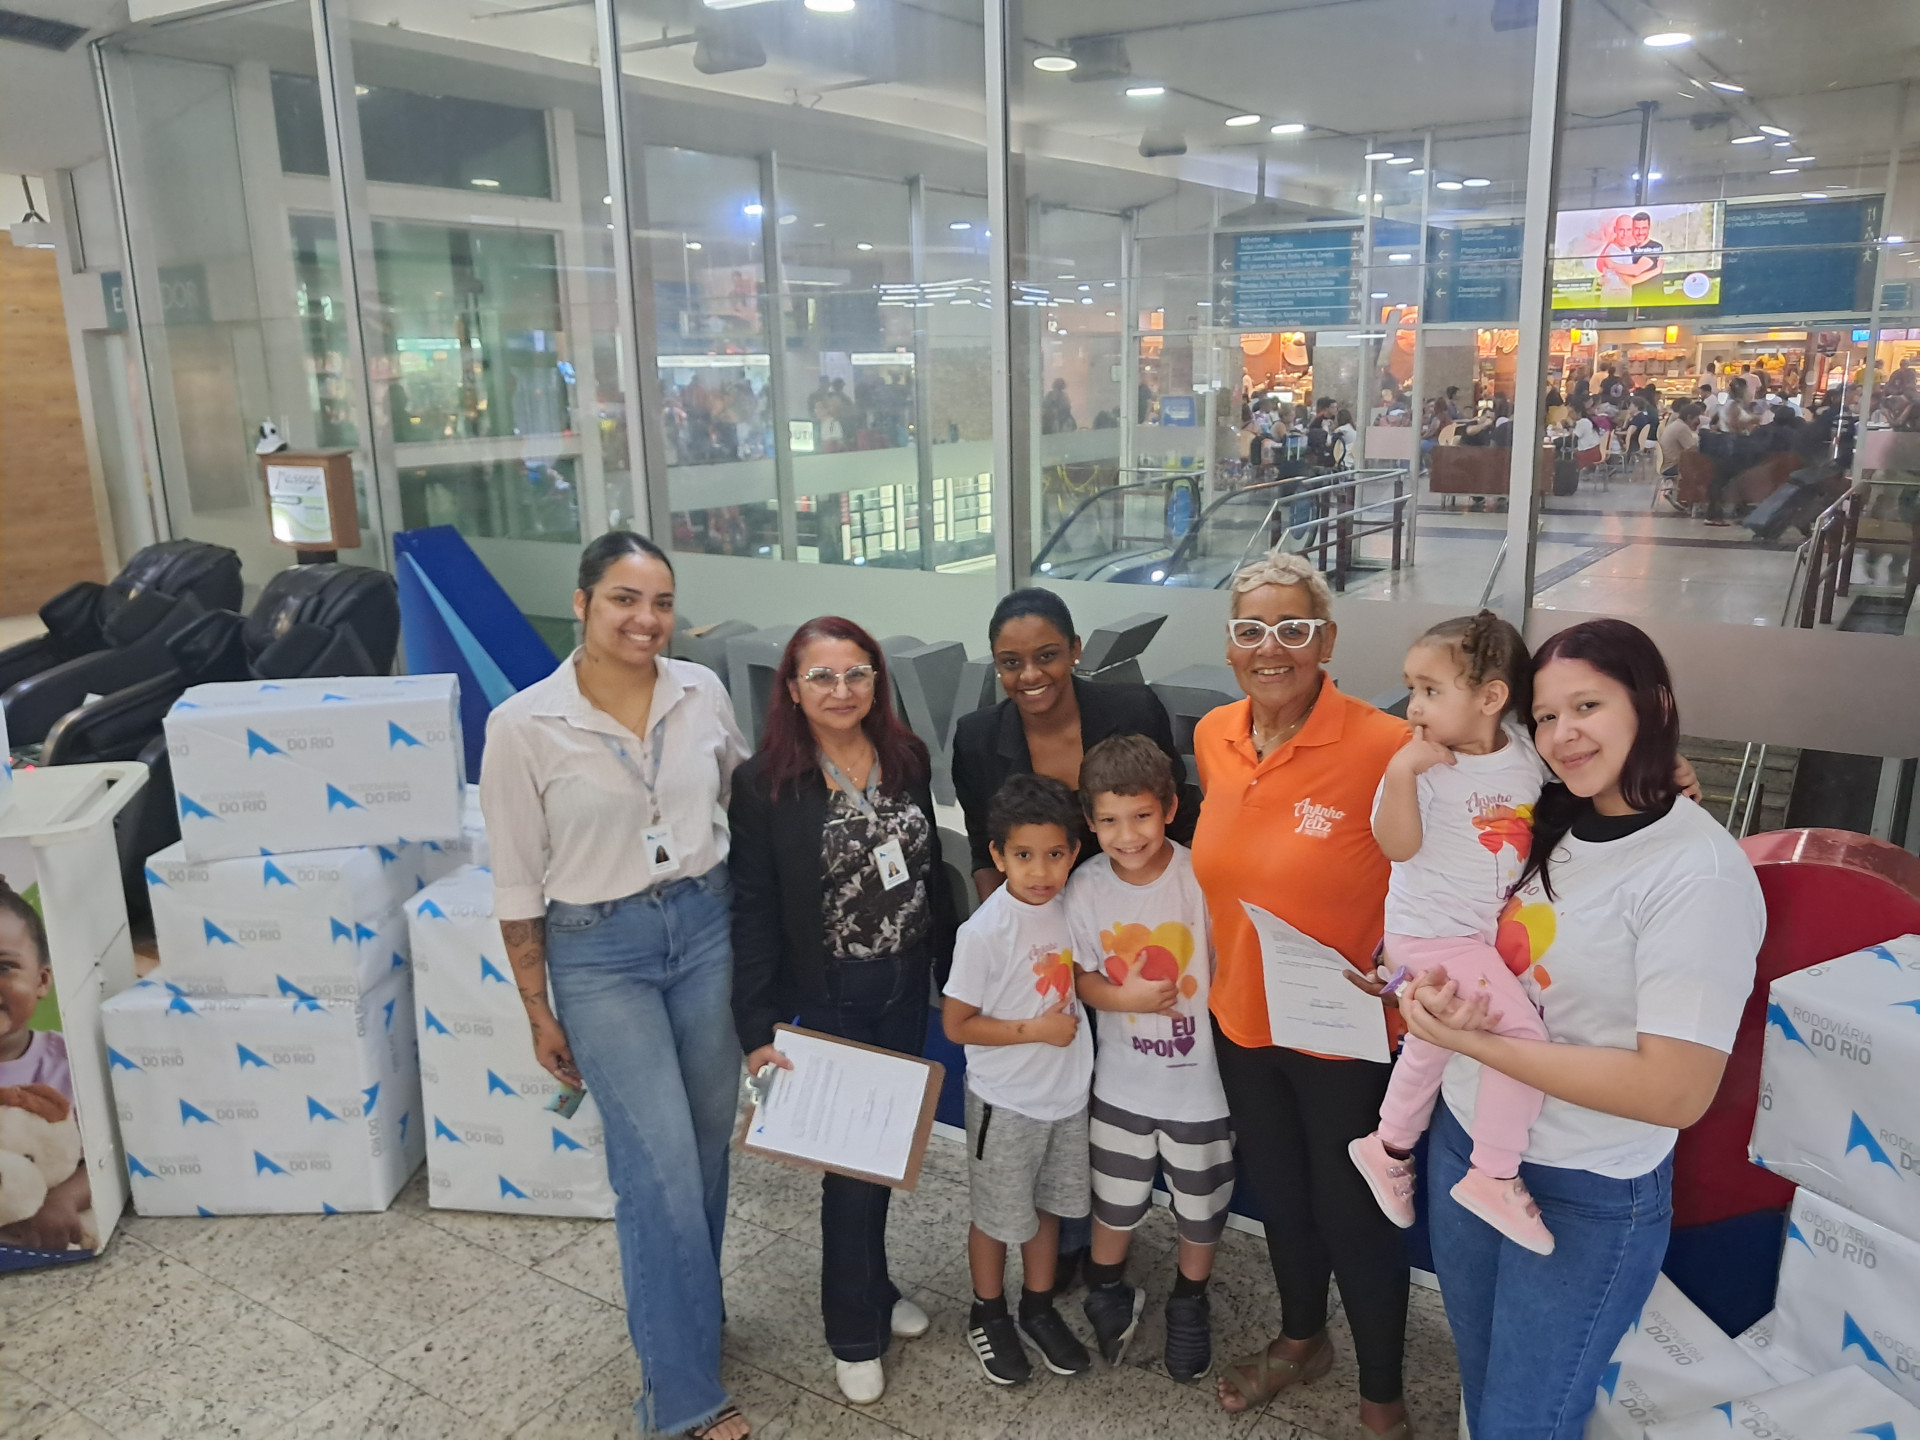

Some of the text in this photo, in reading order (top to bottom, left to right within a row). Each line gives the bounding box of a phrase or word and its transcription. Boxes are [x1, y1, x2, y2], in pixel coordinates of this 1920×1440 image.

[287, 737, 308, 751] DO
[365, 792, 385, 805] DO
[218, 801, 240, 814] DO
[238, 929, 257, 942] DO
[1172, 1016, 1195, 1037] EU
[1792, 1006, 1873, 1047] RODOVIÁRIA
[1810, 1028, 1872, 1066] DO RIO
[142, 1055, 159, 1068] DO
[273, 1052, 291, 1065] DO
[216, 1107, 235, 1121] DO
[158, 1163, 177, 1176] DO
[289, 1159, 308, 1172] DO
[1813, 1228, 1877, 1270] DO RIO
[1644, 1325, 1693, 1367] DO RIO
[1618, 1397, 1647, 1419] DO
[1740, 1417, 1772, 1438] DO
